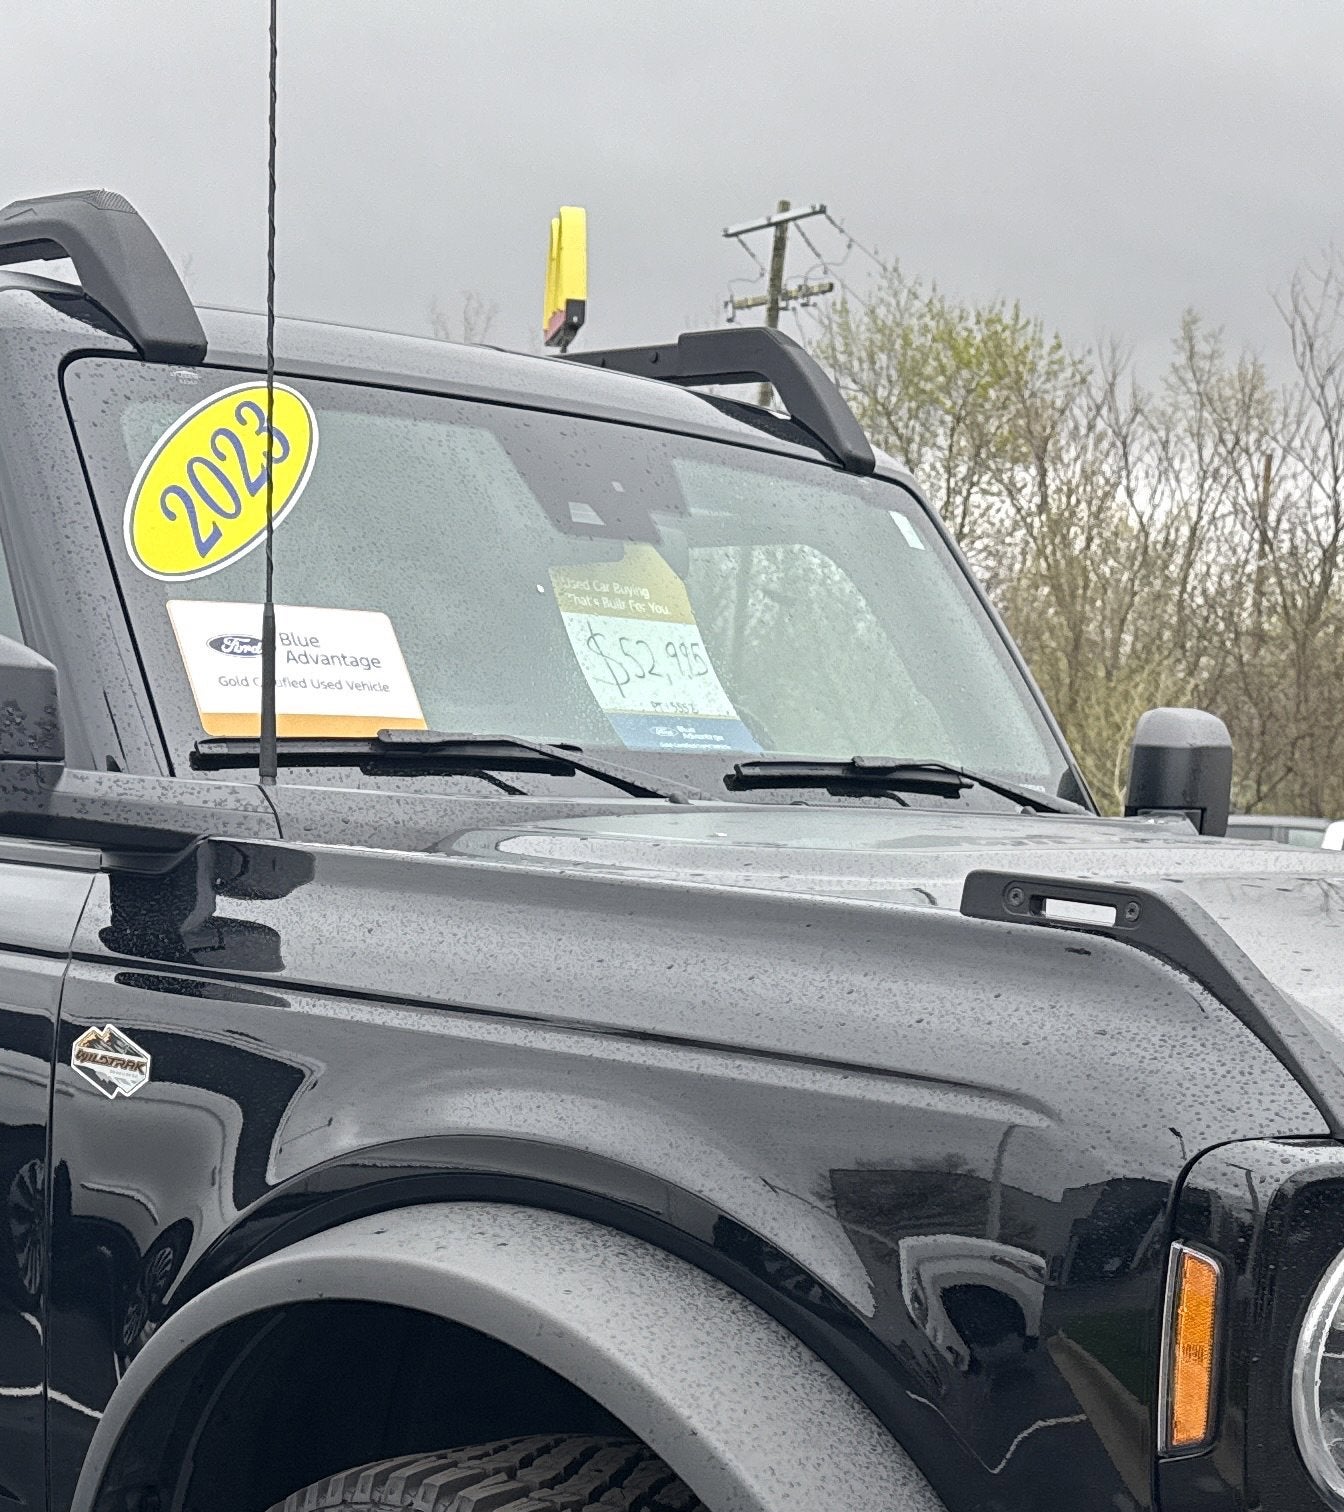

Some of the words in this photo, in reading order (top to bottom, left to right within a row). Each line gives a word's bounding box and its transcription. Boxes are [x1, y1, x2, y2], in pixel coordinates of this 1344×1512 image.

[160, 400, 290, 558] 2023
[593, 580, 609, 592] Car
[613, 583, 650, 599] Buying
[279, 632, 321, 648] Blue
[286, 650, 382, 670] Advantage
[218, 675, 249, 687] Gold
[310, 679, 343, 690] Used
[345, 680, 390, 693] Vehicle
[76, 1048, 147, 1075] WILDTRAK
